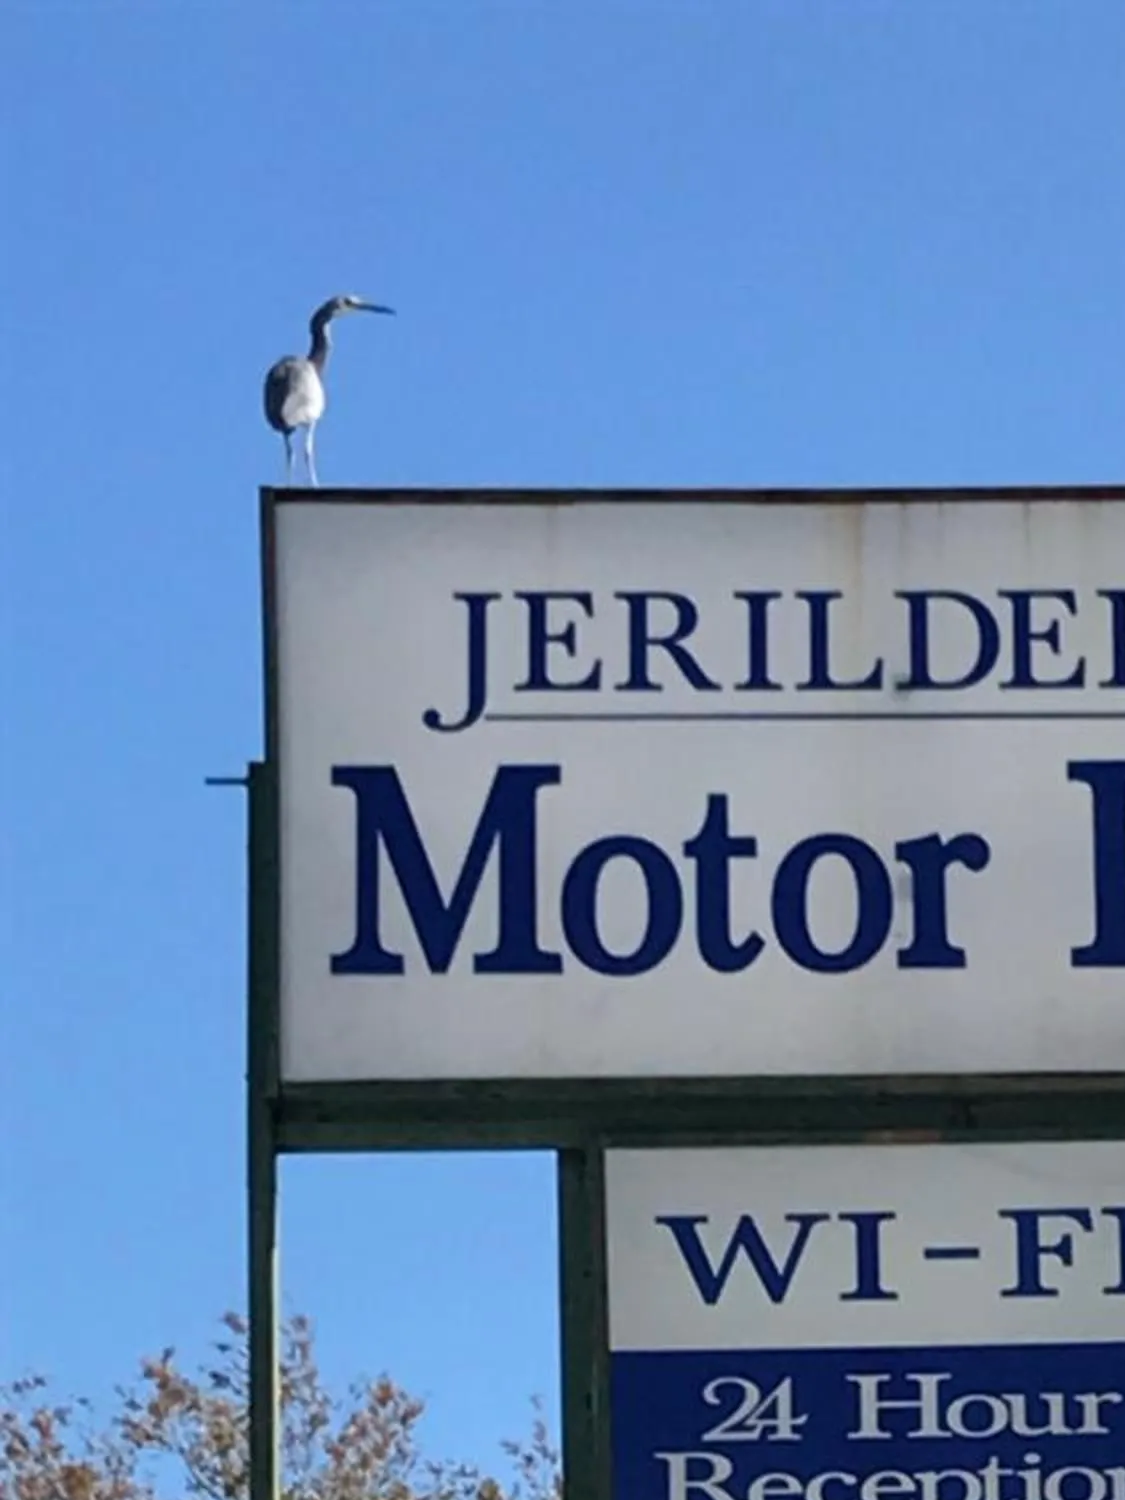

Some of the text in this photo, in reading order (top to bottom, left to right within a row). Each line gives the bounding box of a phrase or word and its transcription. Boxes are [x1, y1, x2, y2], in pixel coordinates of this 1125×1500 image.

[328, 762, 990, 976] Motor
[701, 1371, 1123, 1442] 24 Hour
